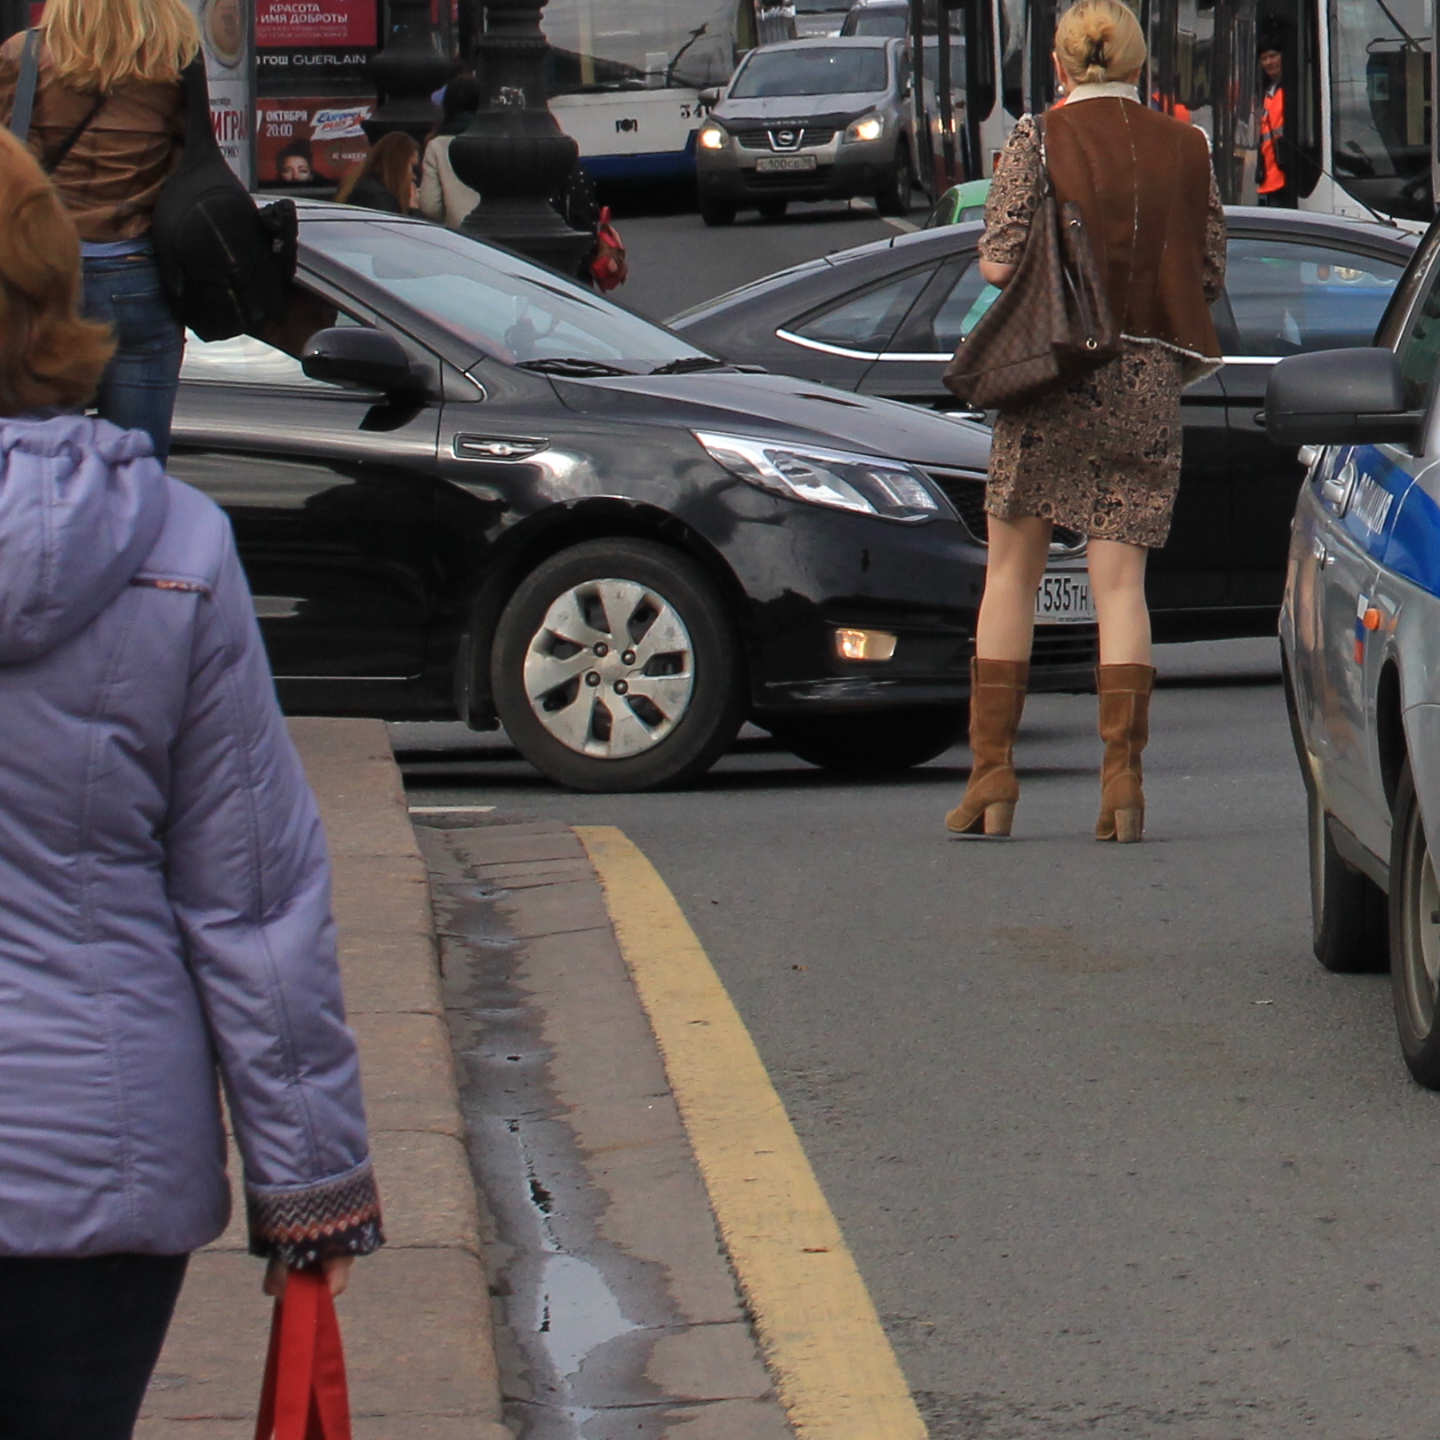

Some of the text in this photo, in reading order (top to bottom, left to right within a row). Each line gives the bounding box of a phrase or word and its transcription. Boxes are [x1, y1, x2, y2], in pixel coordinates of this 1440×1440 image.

[269, 4, 320, 13] КРАСОТА
[261, 13, 348, 25] ИМЯ ДОБРОТЫ
[263, 54, 366, 65] ГОШ GUERLAIN
[266, 110, 307, 122] ОКТЯБРЯ
[266, 123, 293, 137] 20:00
